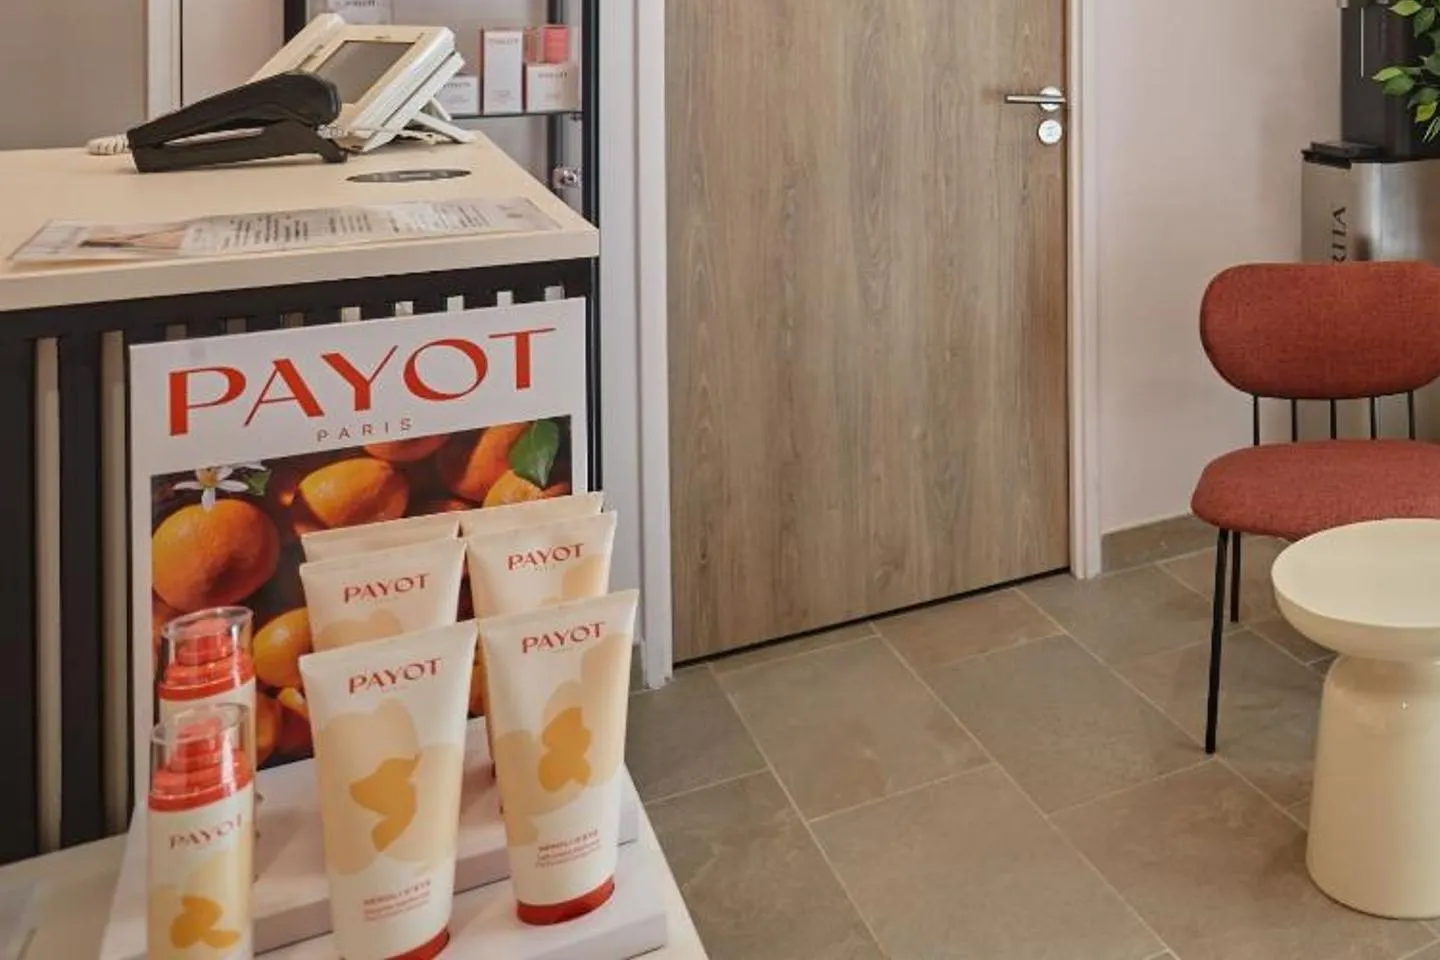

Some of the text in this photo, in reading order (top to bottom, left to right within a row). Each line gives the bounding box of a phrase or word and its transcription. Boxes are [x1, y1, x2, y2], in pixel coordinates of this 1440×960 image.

[168, 327, 557, 437] PAYOT
[317, 417, 414, 442] PARIS
[508, 543, 585, 571] PAYOT
[343, 573, 430, 604] PAYOT
[521, 622, 606, 654] PAYOT
[349, 658, 442, 694] PAYOT
